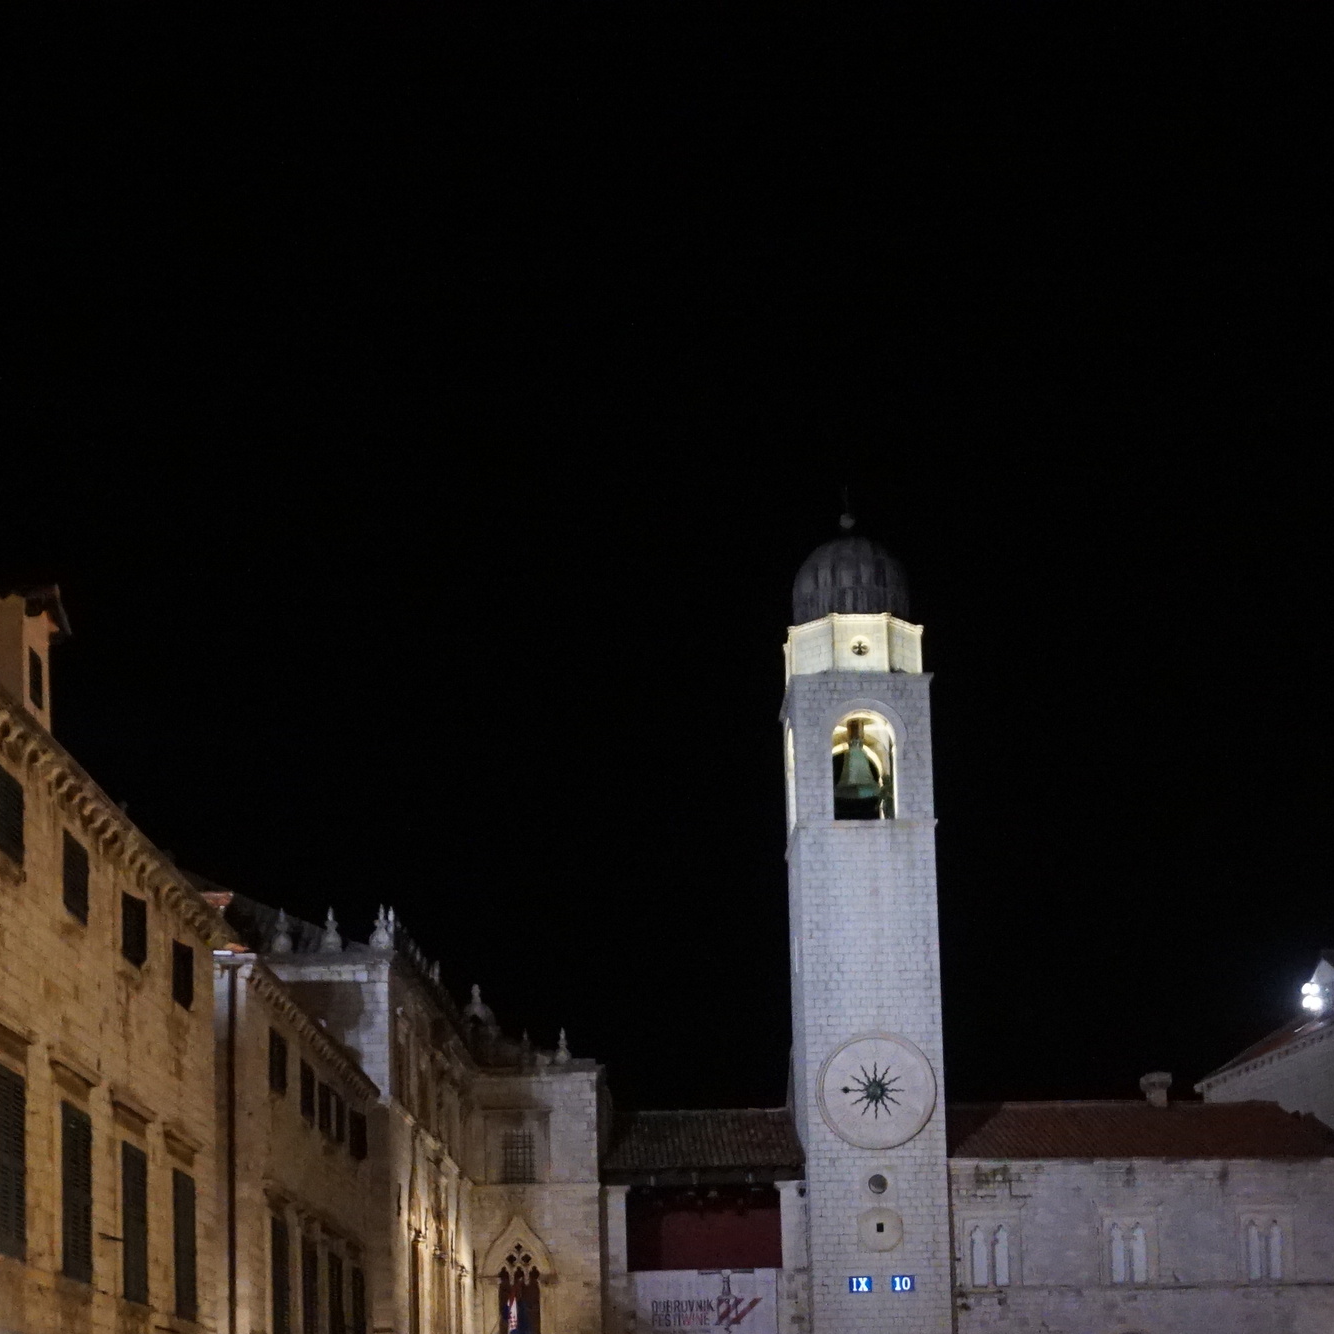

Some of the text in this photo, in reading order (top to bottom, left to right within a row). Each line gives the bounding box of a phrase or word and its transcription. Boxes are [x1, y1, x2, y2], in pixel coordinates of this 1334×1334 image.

[852, 1276, 911, 1292] IX 10
[651, 1299, 715, 1313] DUBROVNIK
[651, 1313, 710, 1327] FESTIWINE
